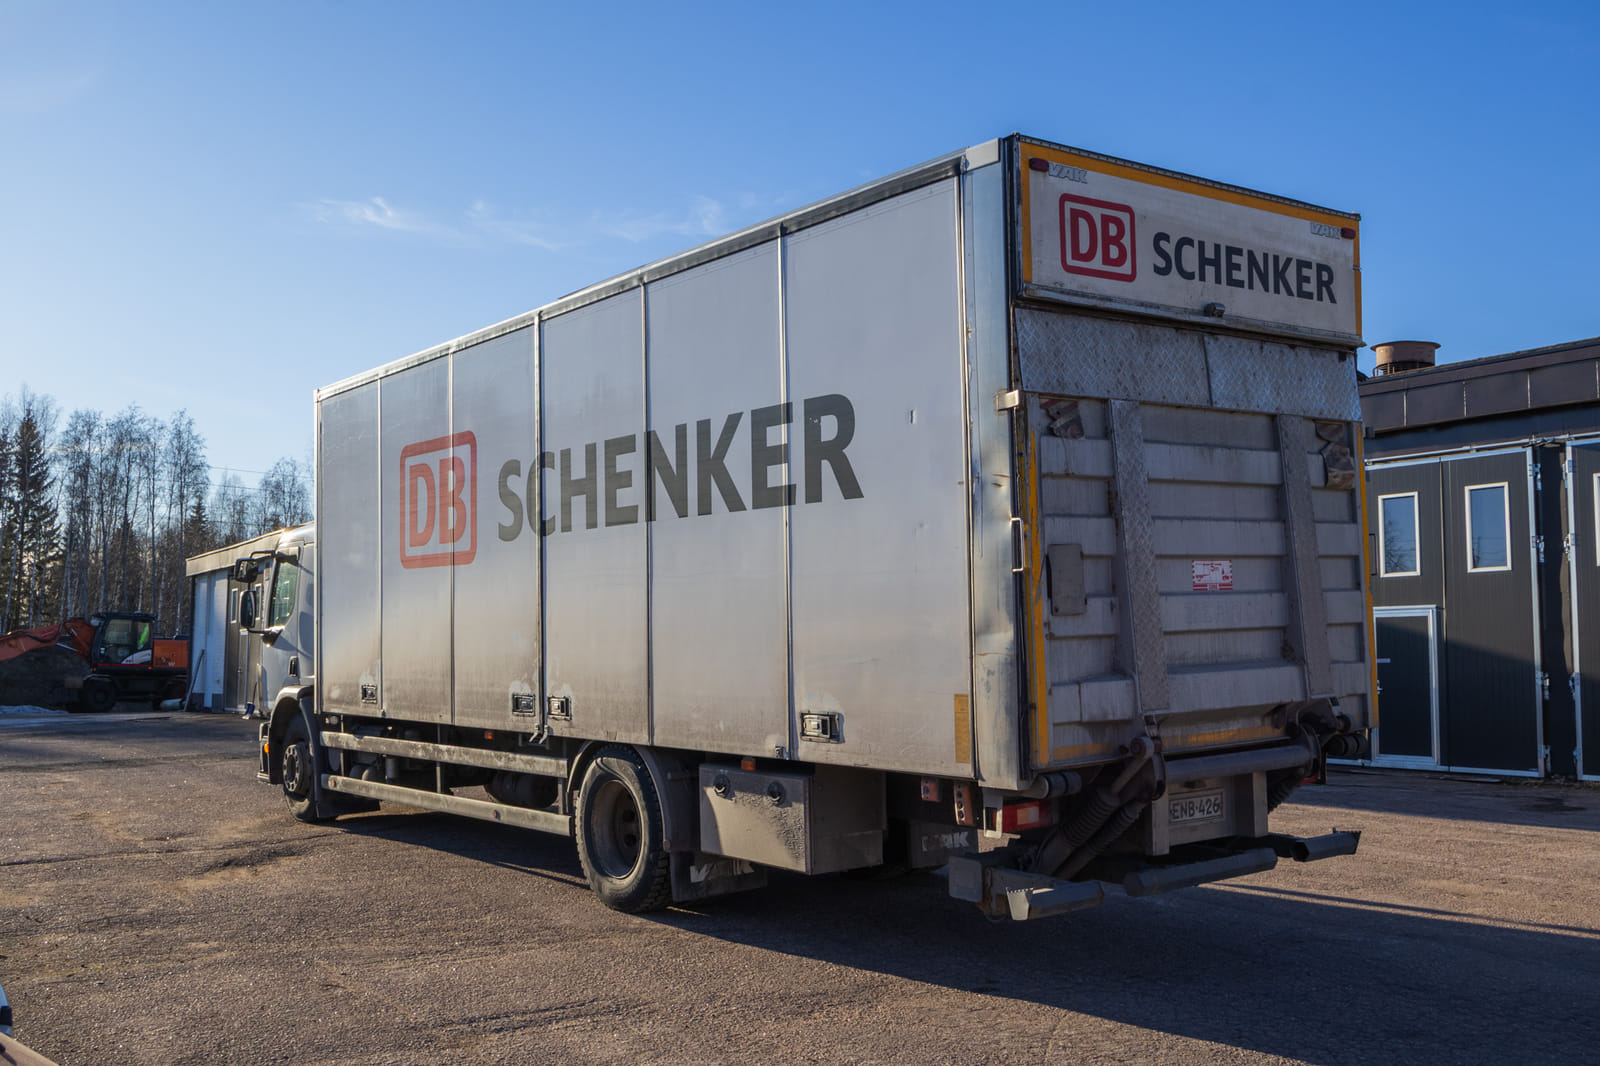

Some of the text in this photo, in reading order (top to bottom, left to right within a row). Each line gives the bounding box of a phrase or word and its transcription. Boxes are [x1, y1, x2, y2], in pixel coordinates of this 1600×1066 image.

[1048, 161, 1088, 184] VAK
[1069, 206, 1338, 304] DB SCHENKER
[408, 393, 865, 548] DB SCHENKER
